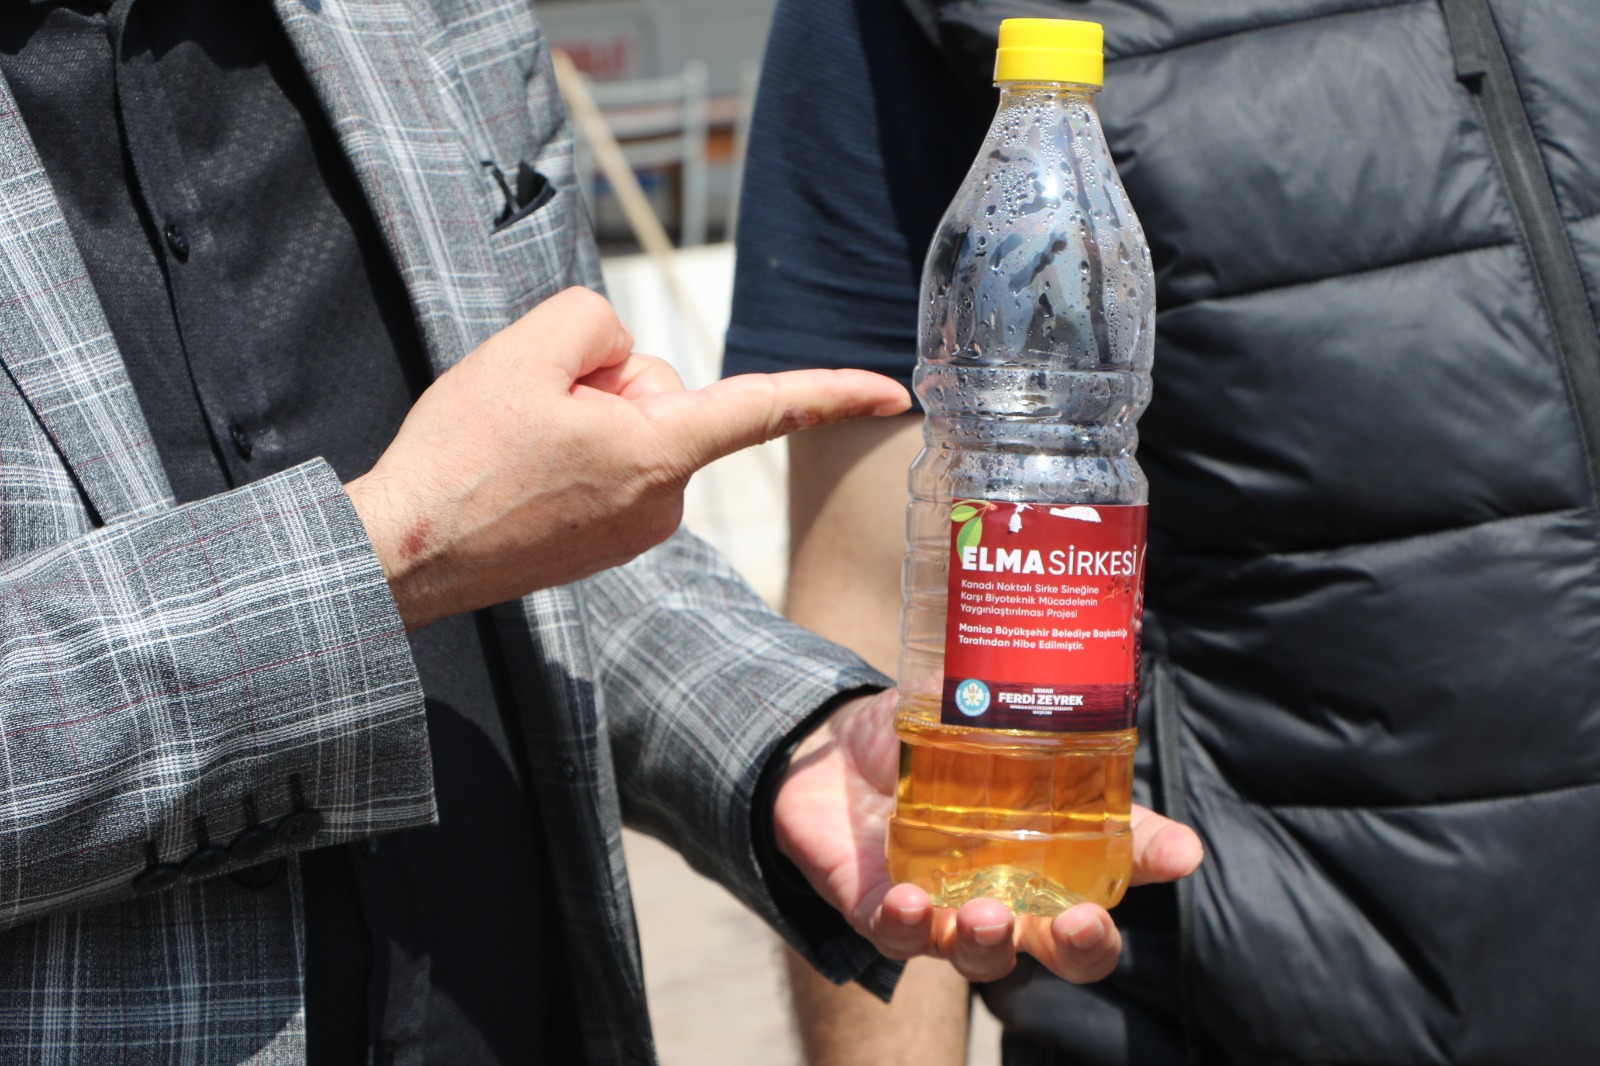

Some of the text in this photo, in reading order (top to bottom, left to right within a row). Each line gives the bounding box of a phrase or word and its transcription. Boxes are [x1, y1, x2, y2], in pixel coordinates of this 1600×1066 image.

[962, 544, 1137, 575] ELMA SİRKESİ
[961, 579, 1099, 596] Kanadı Noktalı Sirke Sineğine
[960, 591, 1098, 606] Karşı Biyoteknik Mücadelenin
[960, 604, 1078, 620] Yaygınlaştırılması Projesi
[959, 623, 993, 634] Manisa
[995, 626, 1049, 638] Büyükşehir
[1052, 628, 1091, 639] Belediye
[958, 635, 1084, 651] Tarafından Hibe Edilmiştir.
[1037, 694, 1084, 706] ZEYREK
